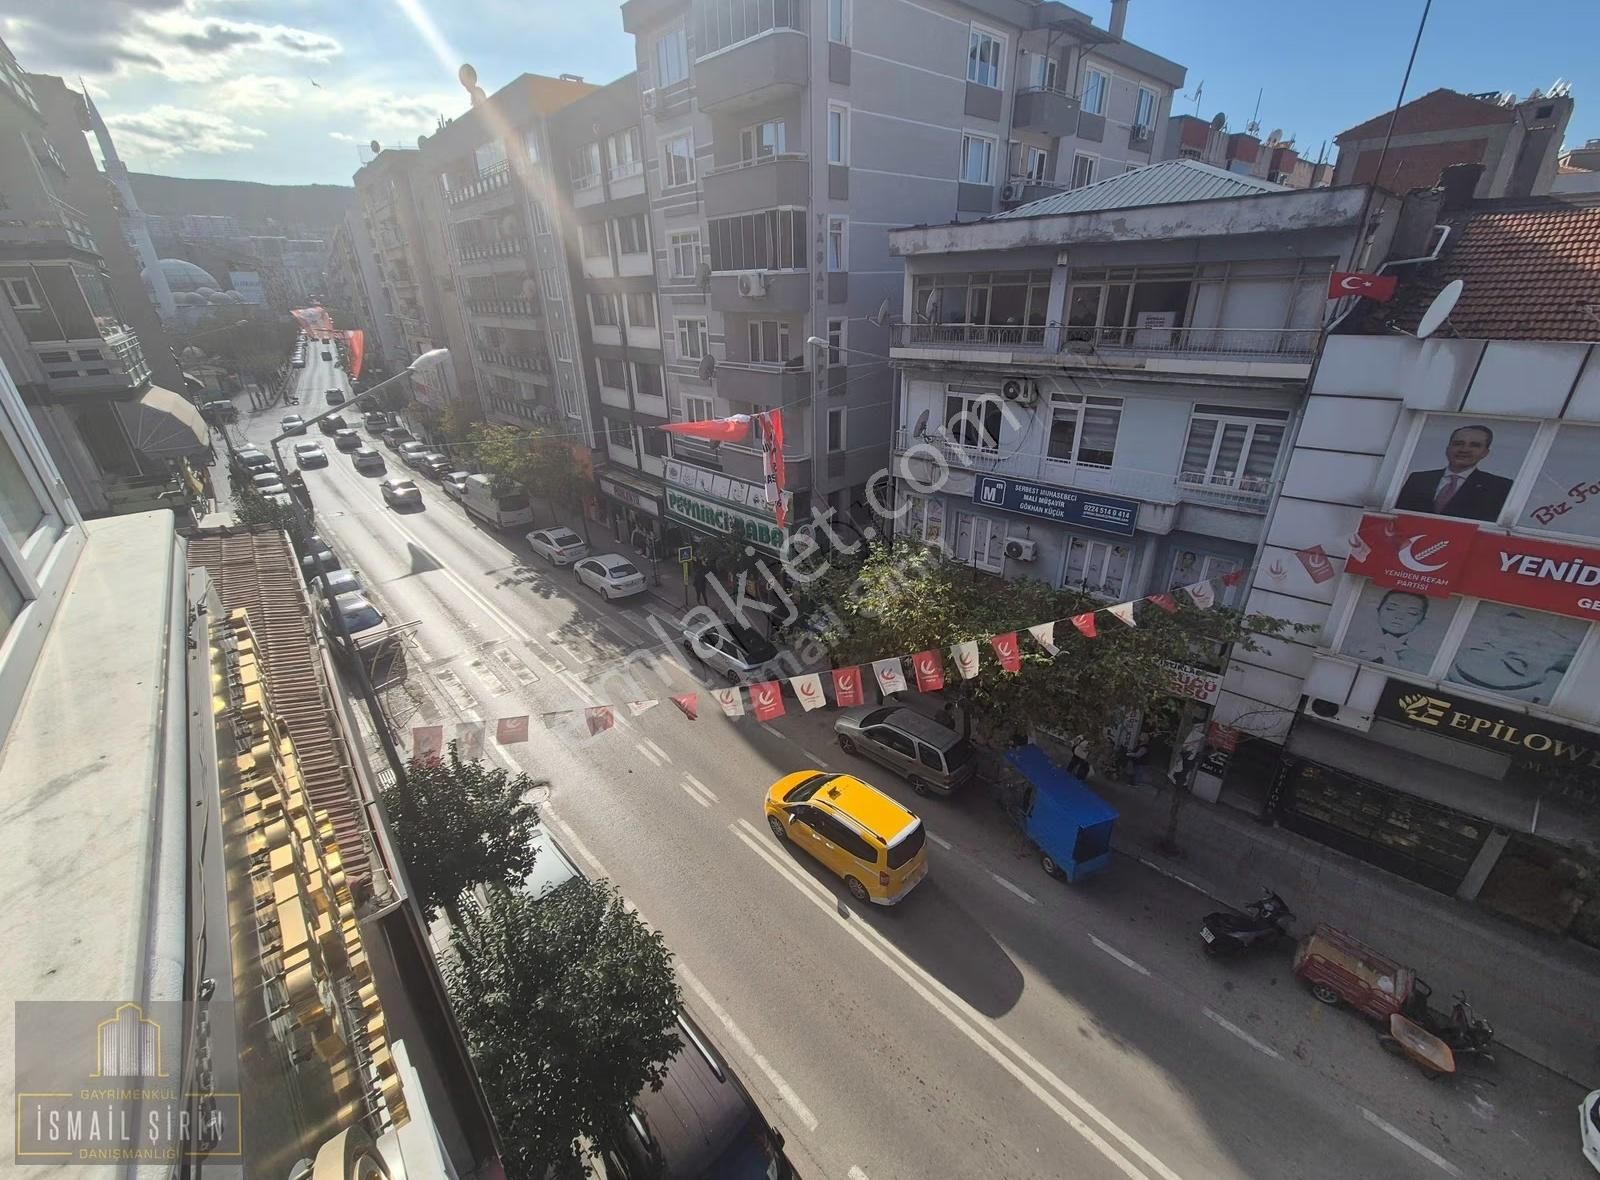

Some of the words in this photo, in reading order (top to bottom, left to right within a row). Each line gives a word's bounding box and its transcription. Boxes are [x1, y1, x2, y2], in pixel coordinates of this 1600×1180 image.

[1015, 484, 1039, 494] SERBEST
[1019, 502, 1044, 513] GÖKHAN
[1530, 501, 1573, 525] Biz
[1567, 481, 1600, 504] Fa
[1384, 568, 1420, 582] YENİDEN
[1420, 575, 1449, 586] REFAH
